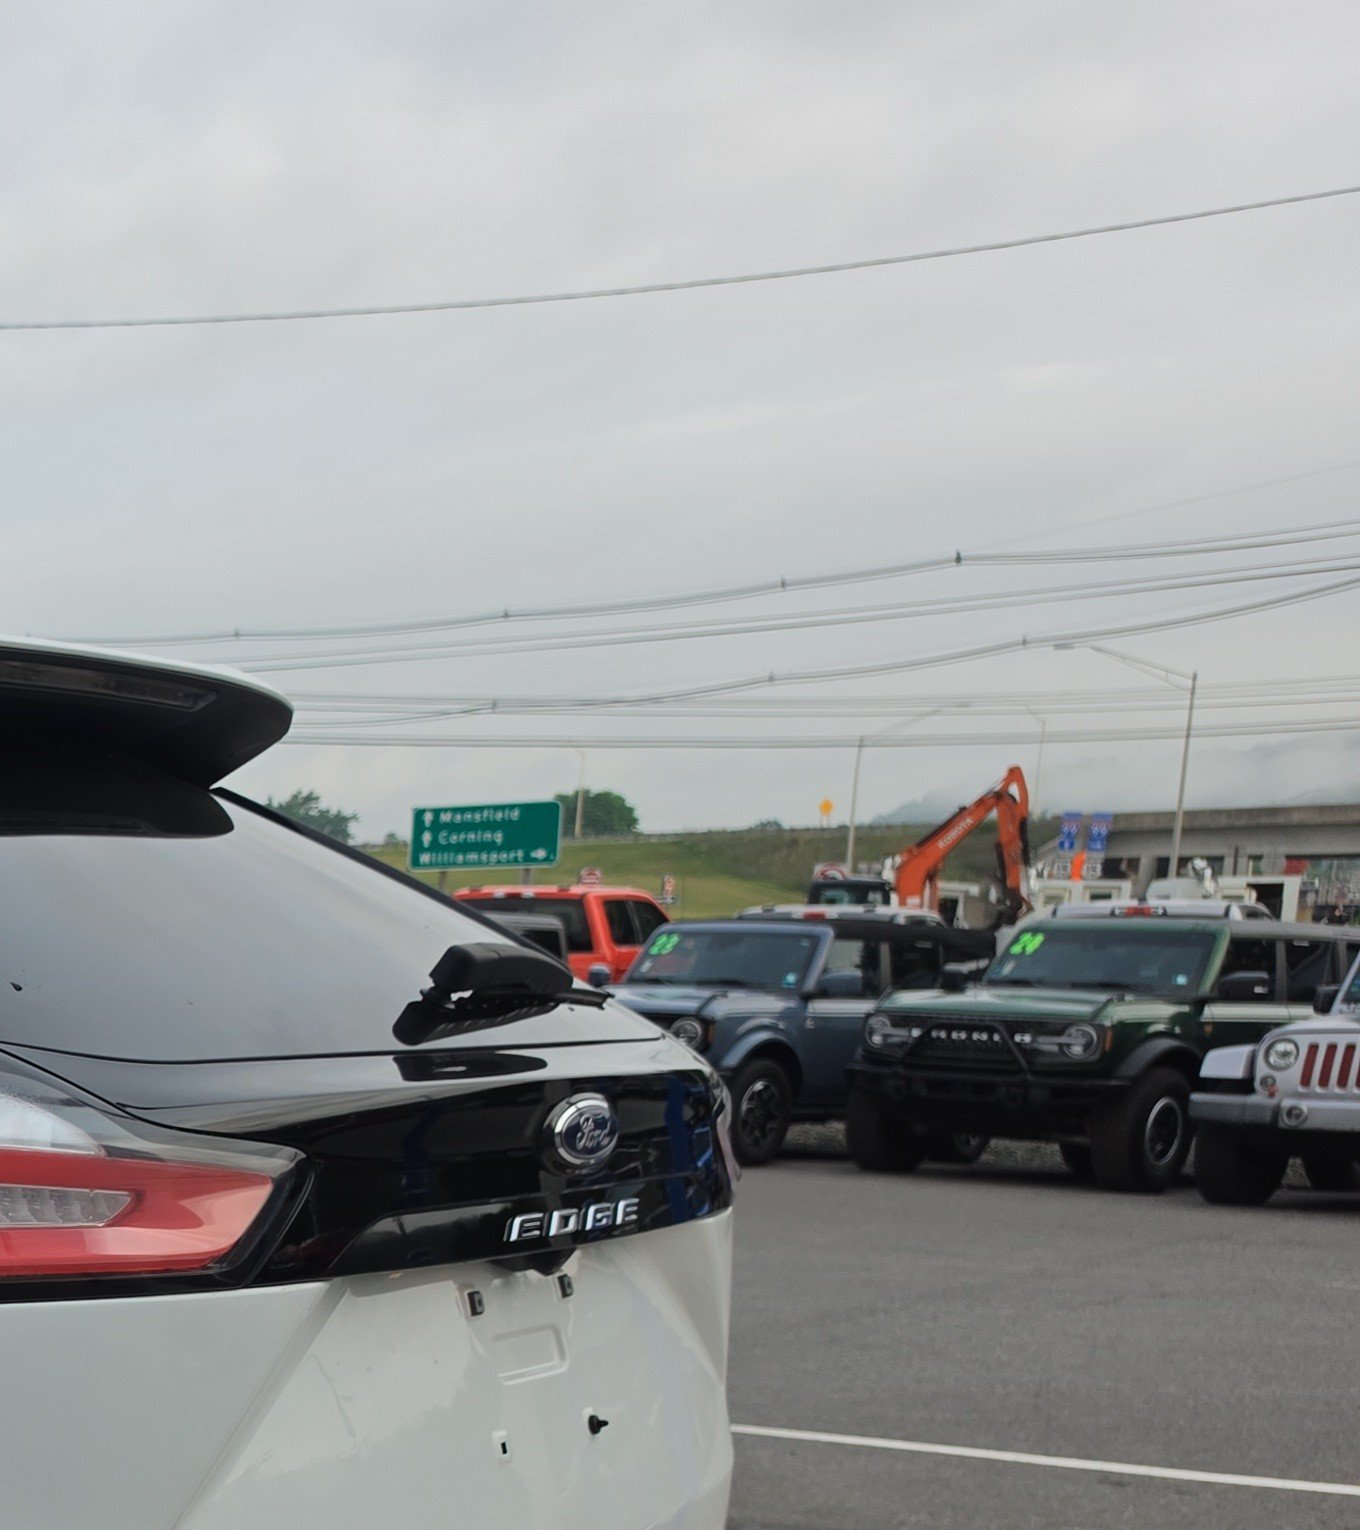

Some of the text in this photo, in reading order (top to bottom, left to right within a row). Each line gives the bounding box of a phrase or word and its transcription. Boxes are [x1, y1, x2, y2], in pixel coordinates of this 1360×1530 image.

[439, 806, 521, 824] Mansfield
[438, 829, 504, 847] Corning
[418, 849, 524, 867] Williamsport
[505, 1198, 640, 1242] EDGE
